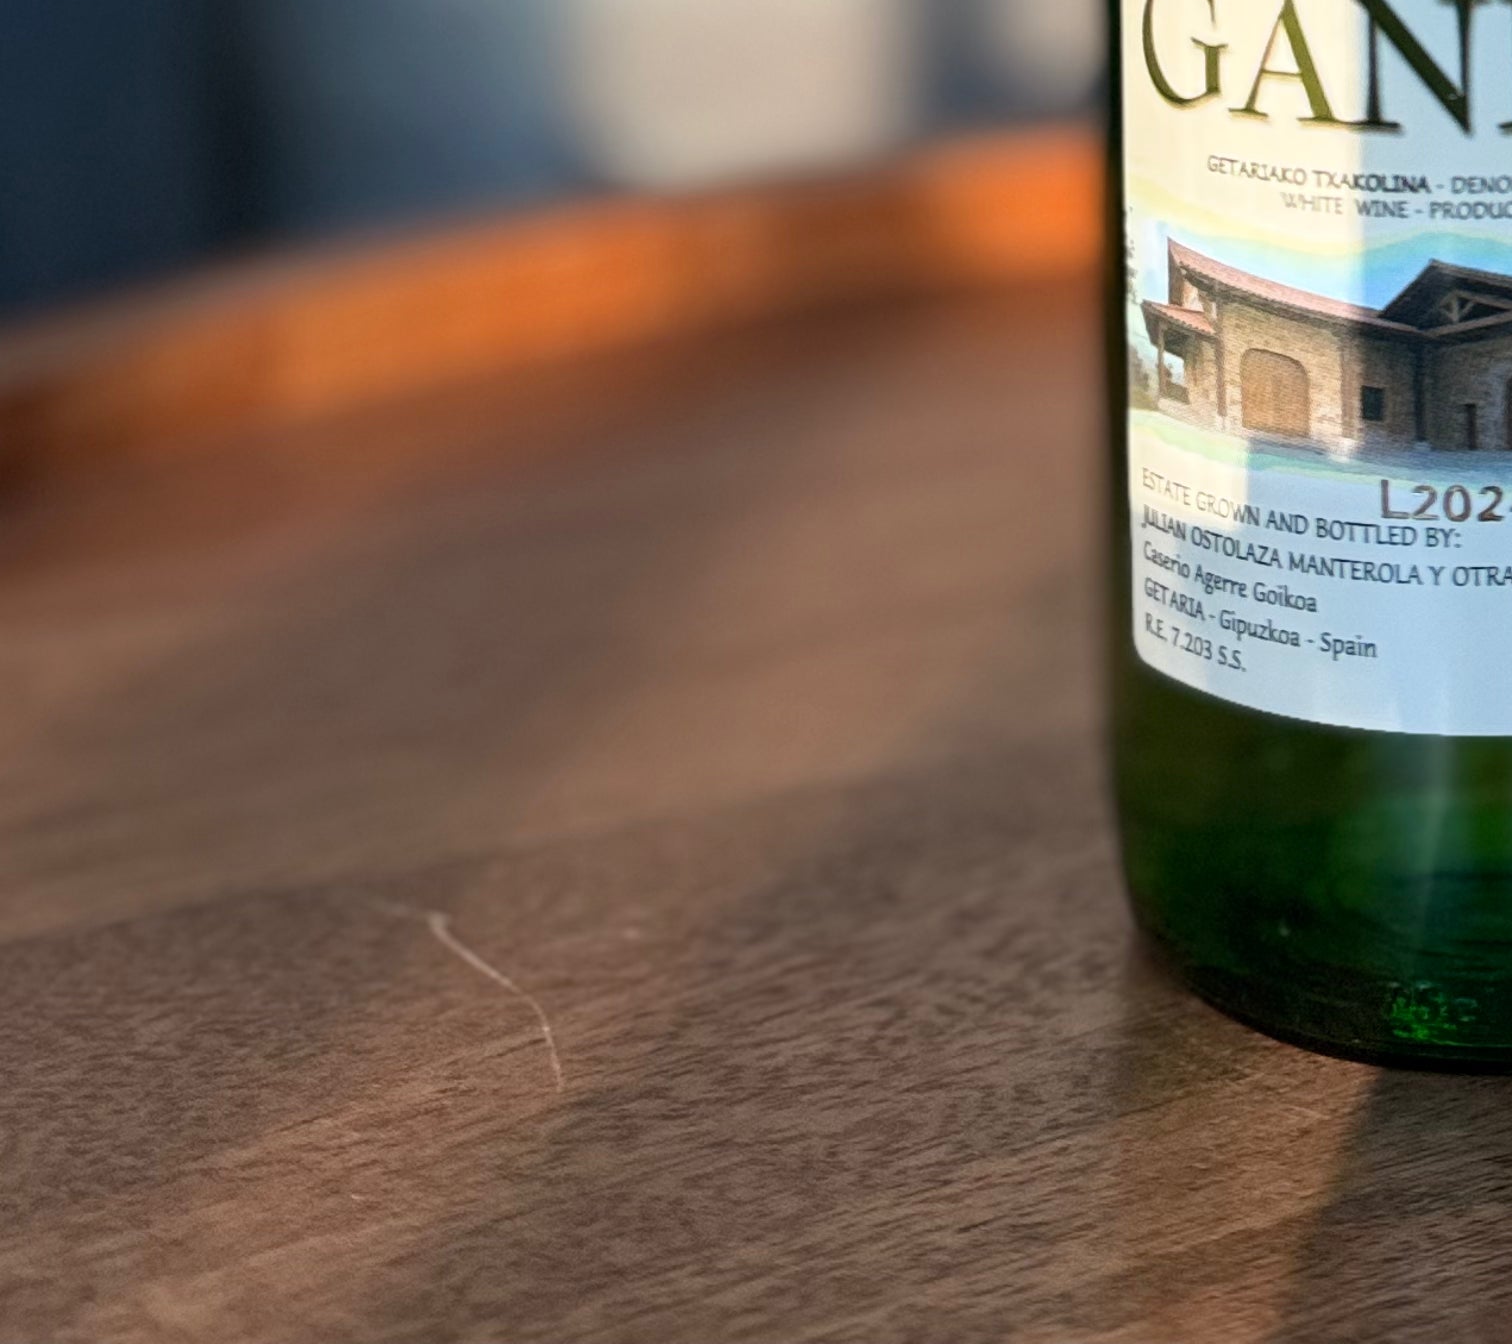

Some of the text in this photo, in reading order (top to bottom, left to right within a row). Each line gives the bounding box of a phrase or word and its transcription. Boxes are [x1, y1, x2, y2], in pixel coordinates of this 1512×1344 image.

[1207, 155, 1307, 185] GETARIAKO
[1312, 170, 1431, 194] TXAKOLINA
[1280, 192, 1343, 214] WHITE
[1355, 198, 1409, 219] WINE
[1142, 467, 1464, 549] ESTATE GROWN AND BOTTLED BY:
[1141, 504, 1186, 541] JULIAN
[1191, 526, 1282, 569] OSTOLAZA
[1288, 552, 1423, 585] MANTEROLA
[1428, 566, 1445, 586] Y
[1194, 564, 1248, 598] Agerre
[1253, 581, 1318, 612] Goikoa
[1219, 609, 1301, 648] Gipuzkoa
[1320, 632, 1379, 660] Spain
